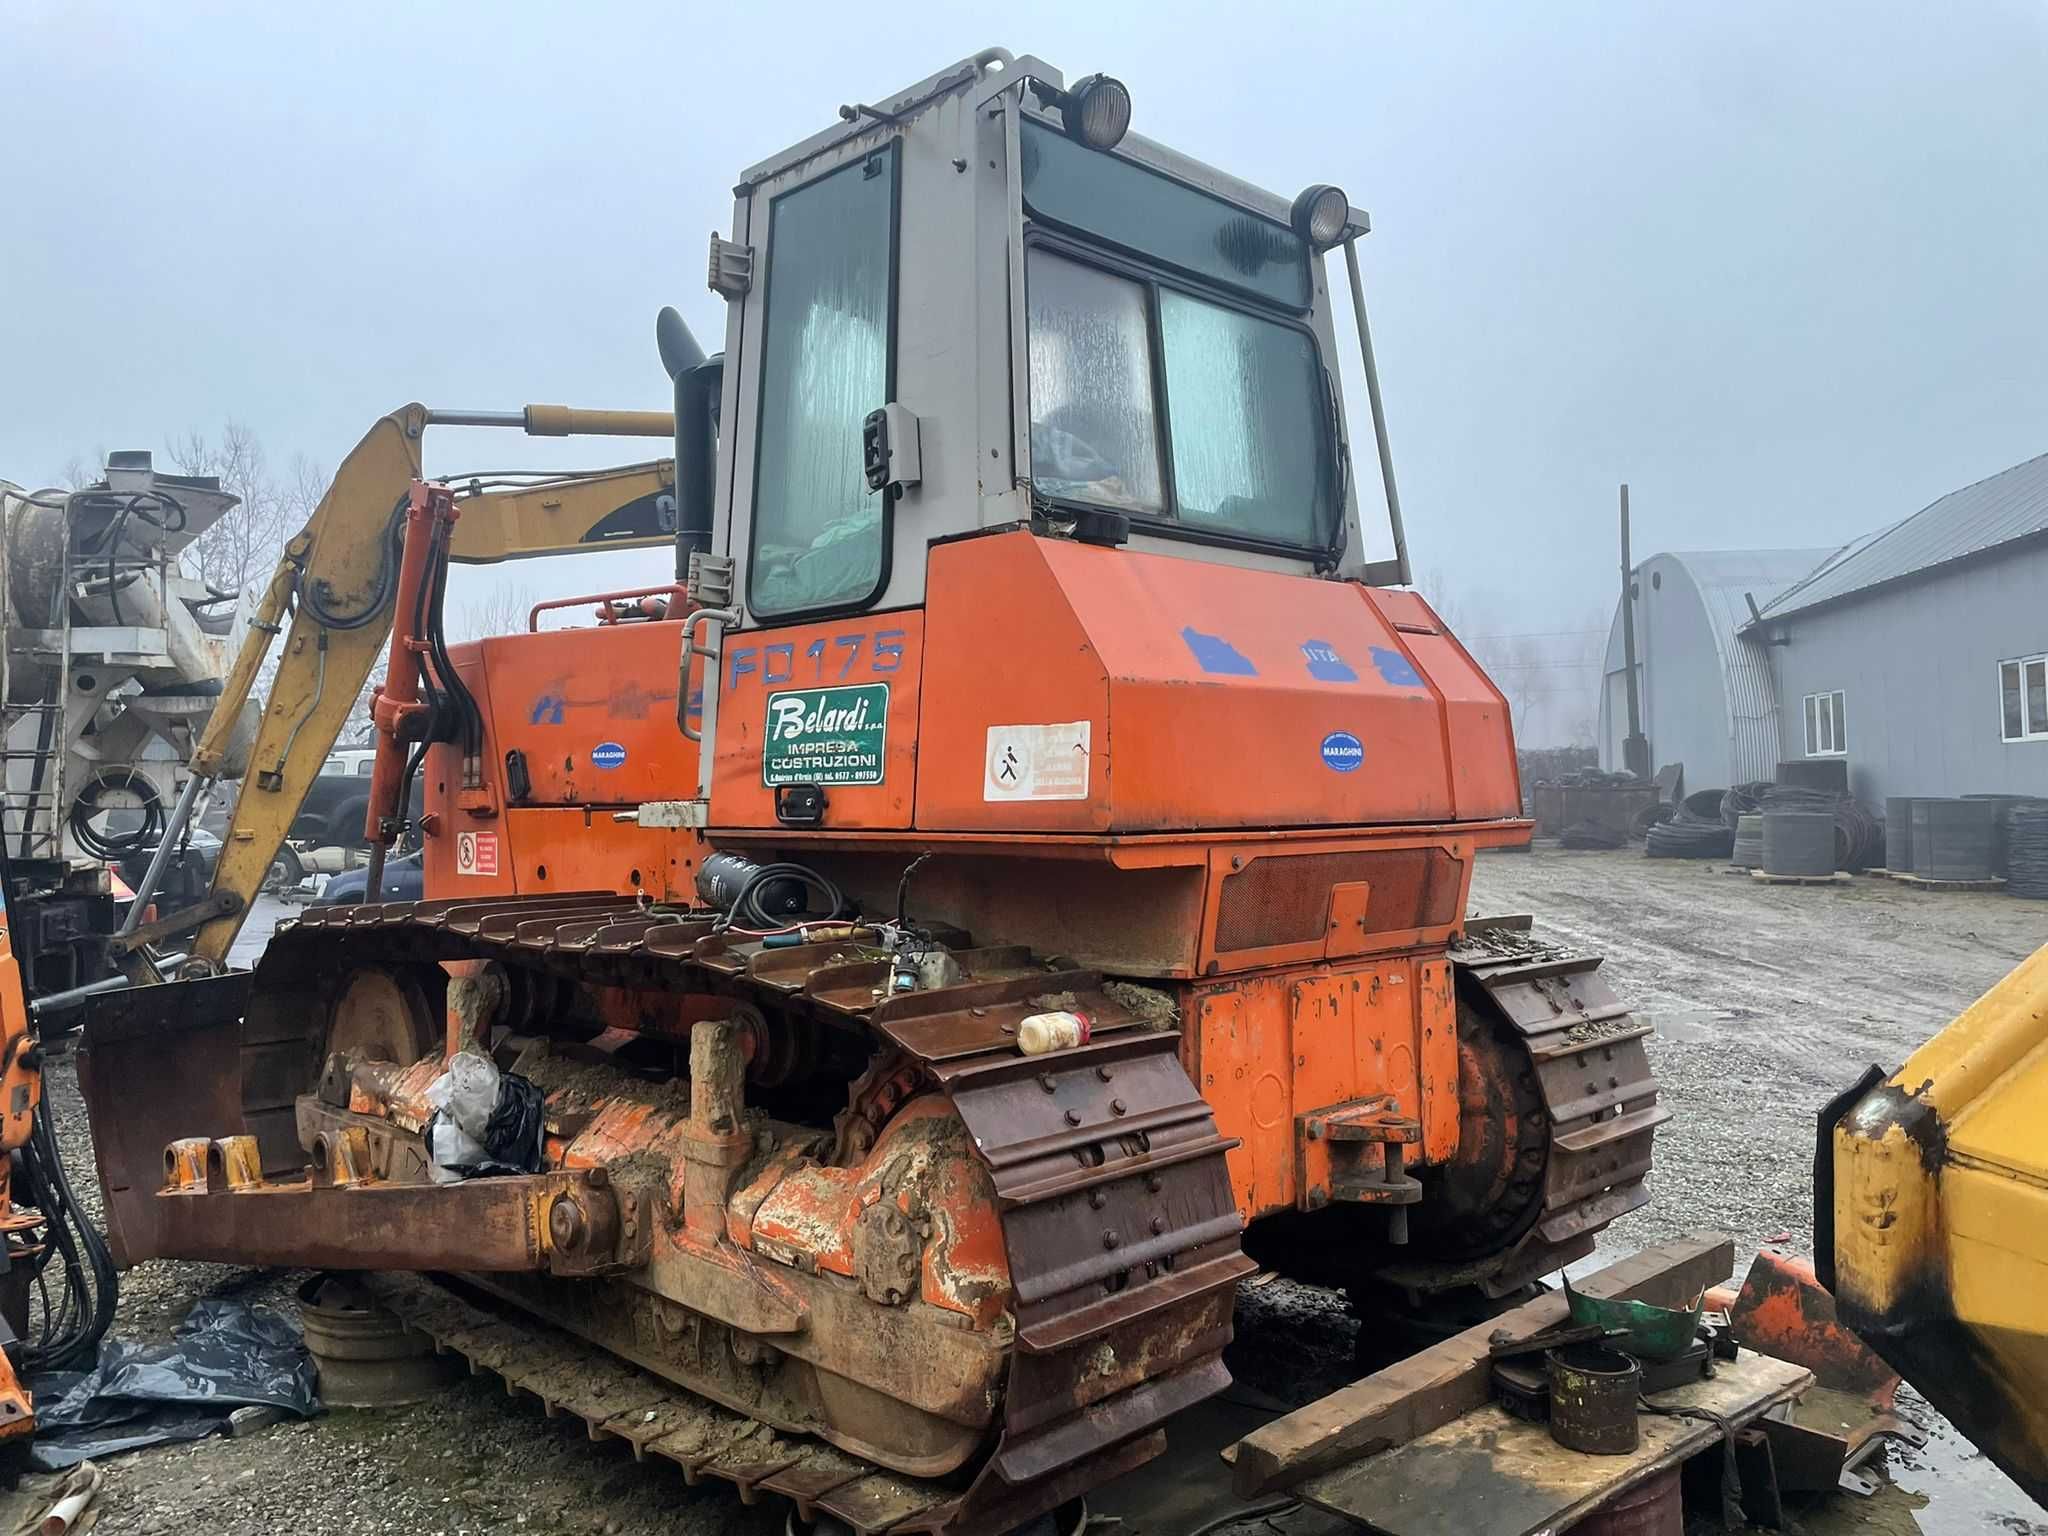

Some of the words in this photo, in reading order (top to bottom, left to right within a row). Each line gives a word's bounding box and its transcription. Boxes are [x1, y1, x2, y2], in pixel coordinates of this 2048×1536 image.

[771, 695, 869, 741] Belardi
[788, 741, 858, 755] IMPRESA
[771, 754, 876, 769] COSTRUZIONI
